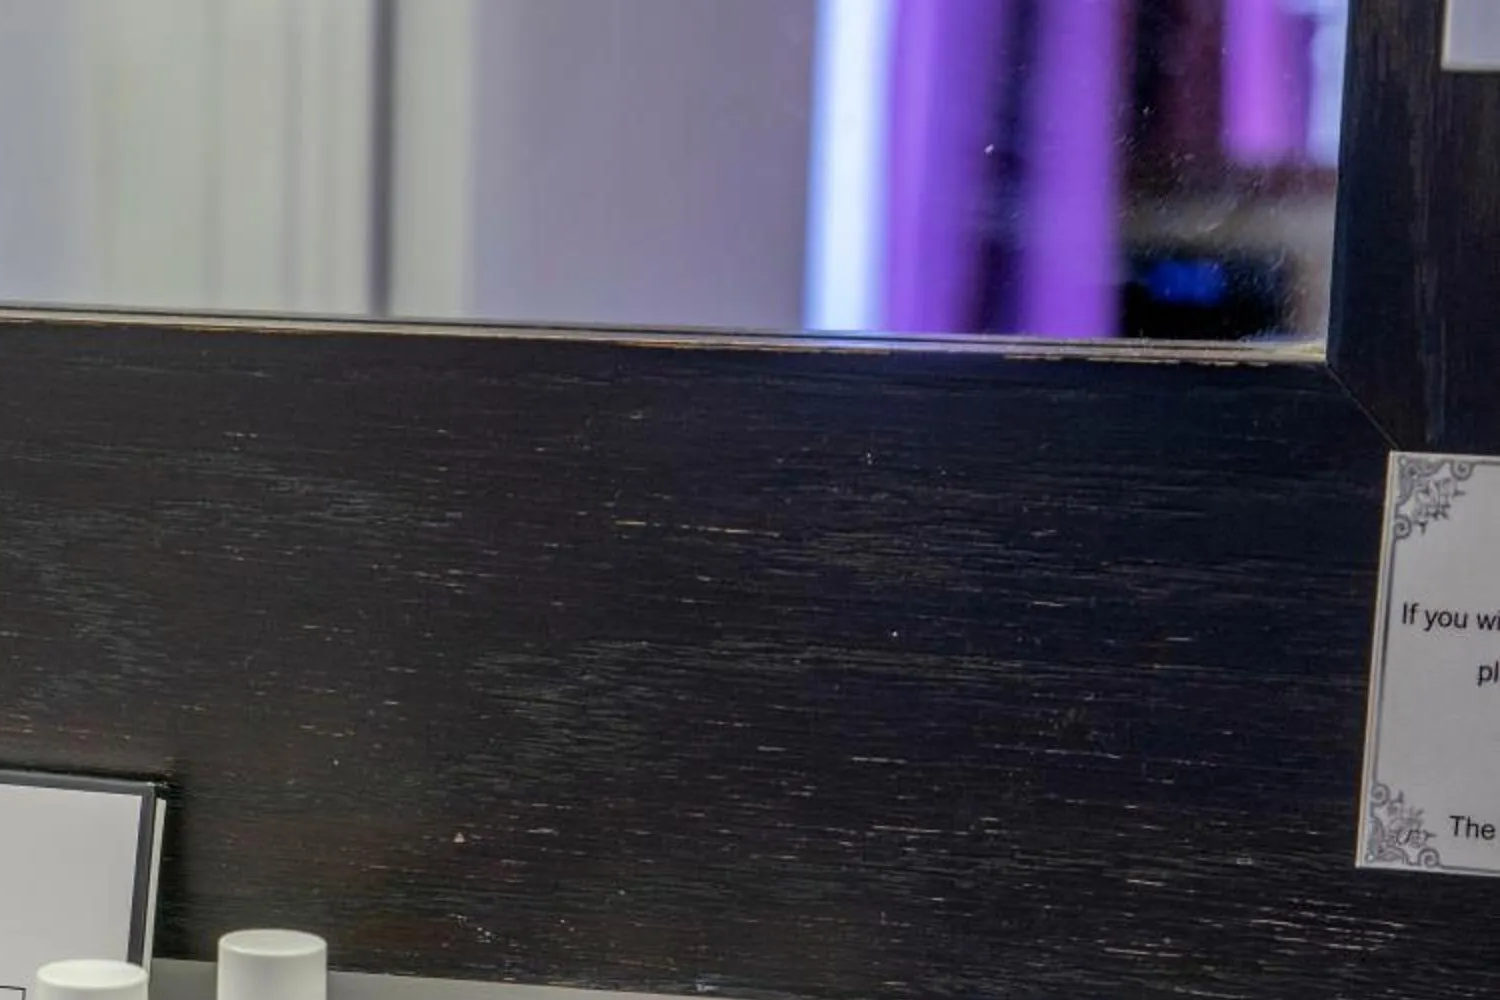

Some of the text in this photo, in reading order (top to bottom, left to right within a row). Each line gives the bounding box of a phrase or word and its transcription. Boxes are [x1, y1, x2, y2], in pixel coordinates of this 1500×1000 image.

[1402, 602, 1419, 625] If
[1423, 609, 1468, 632] you
[1449, 815, 1496, 840] The
